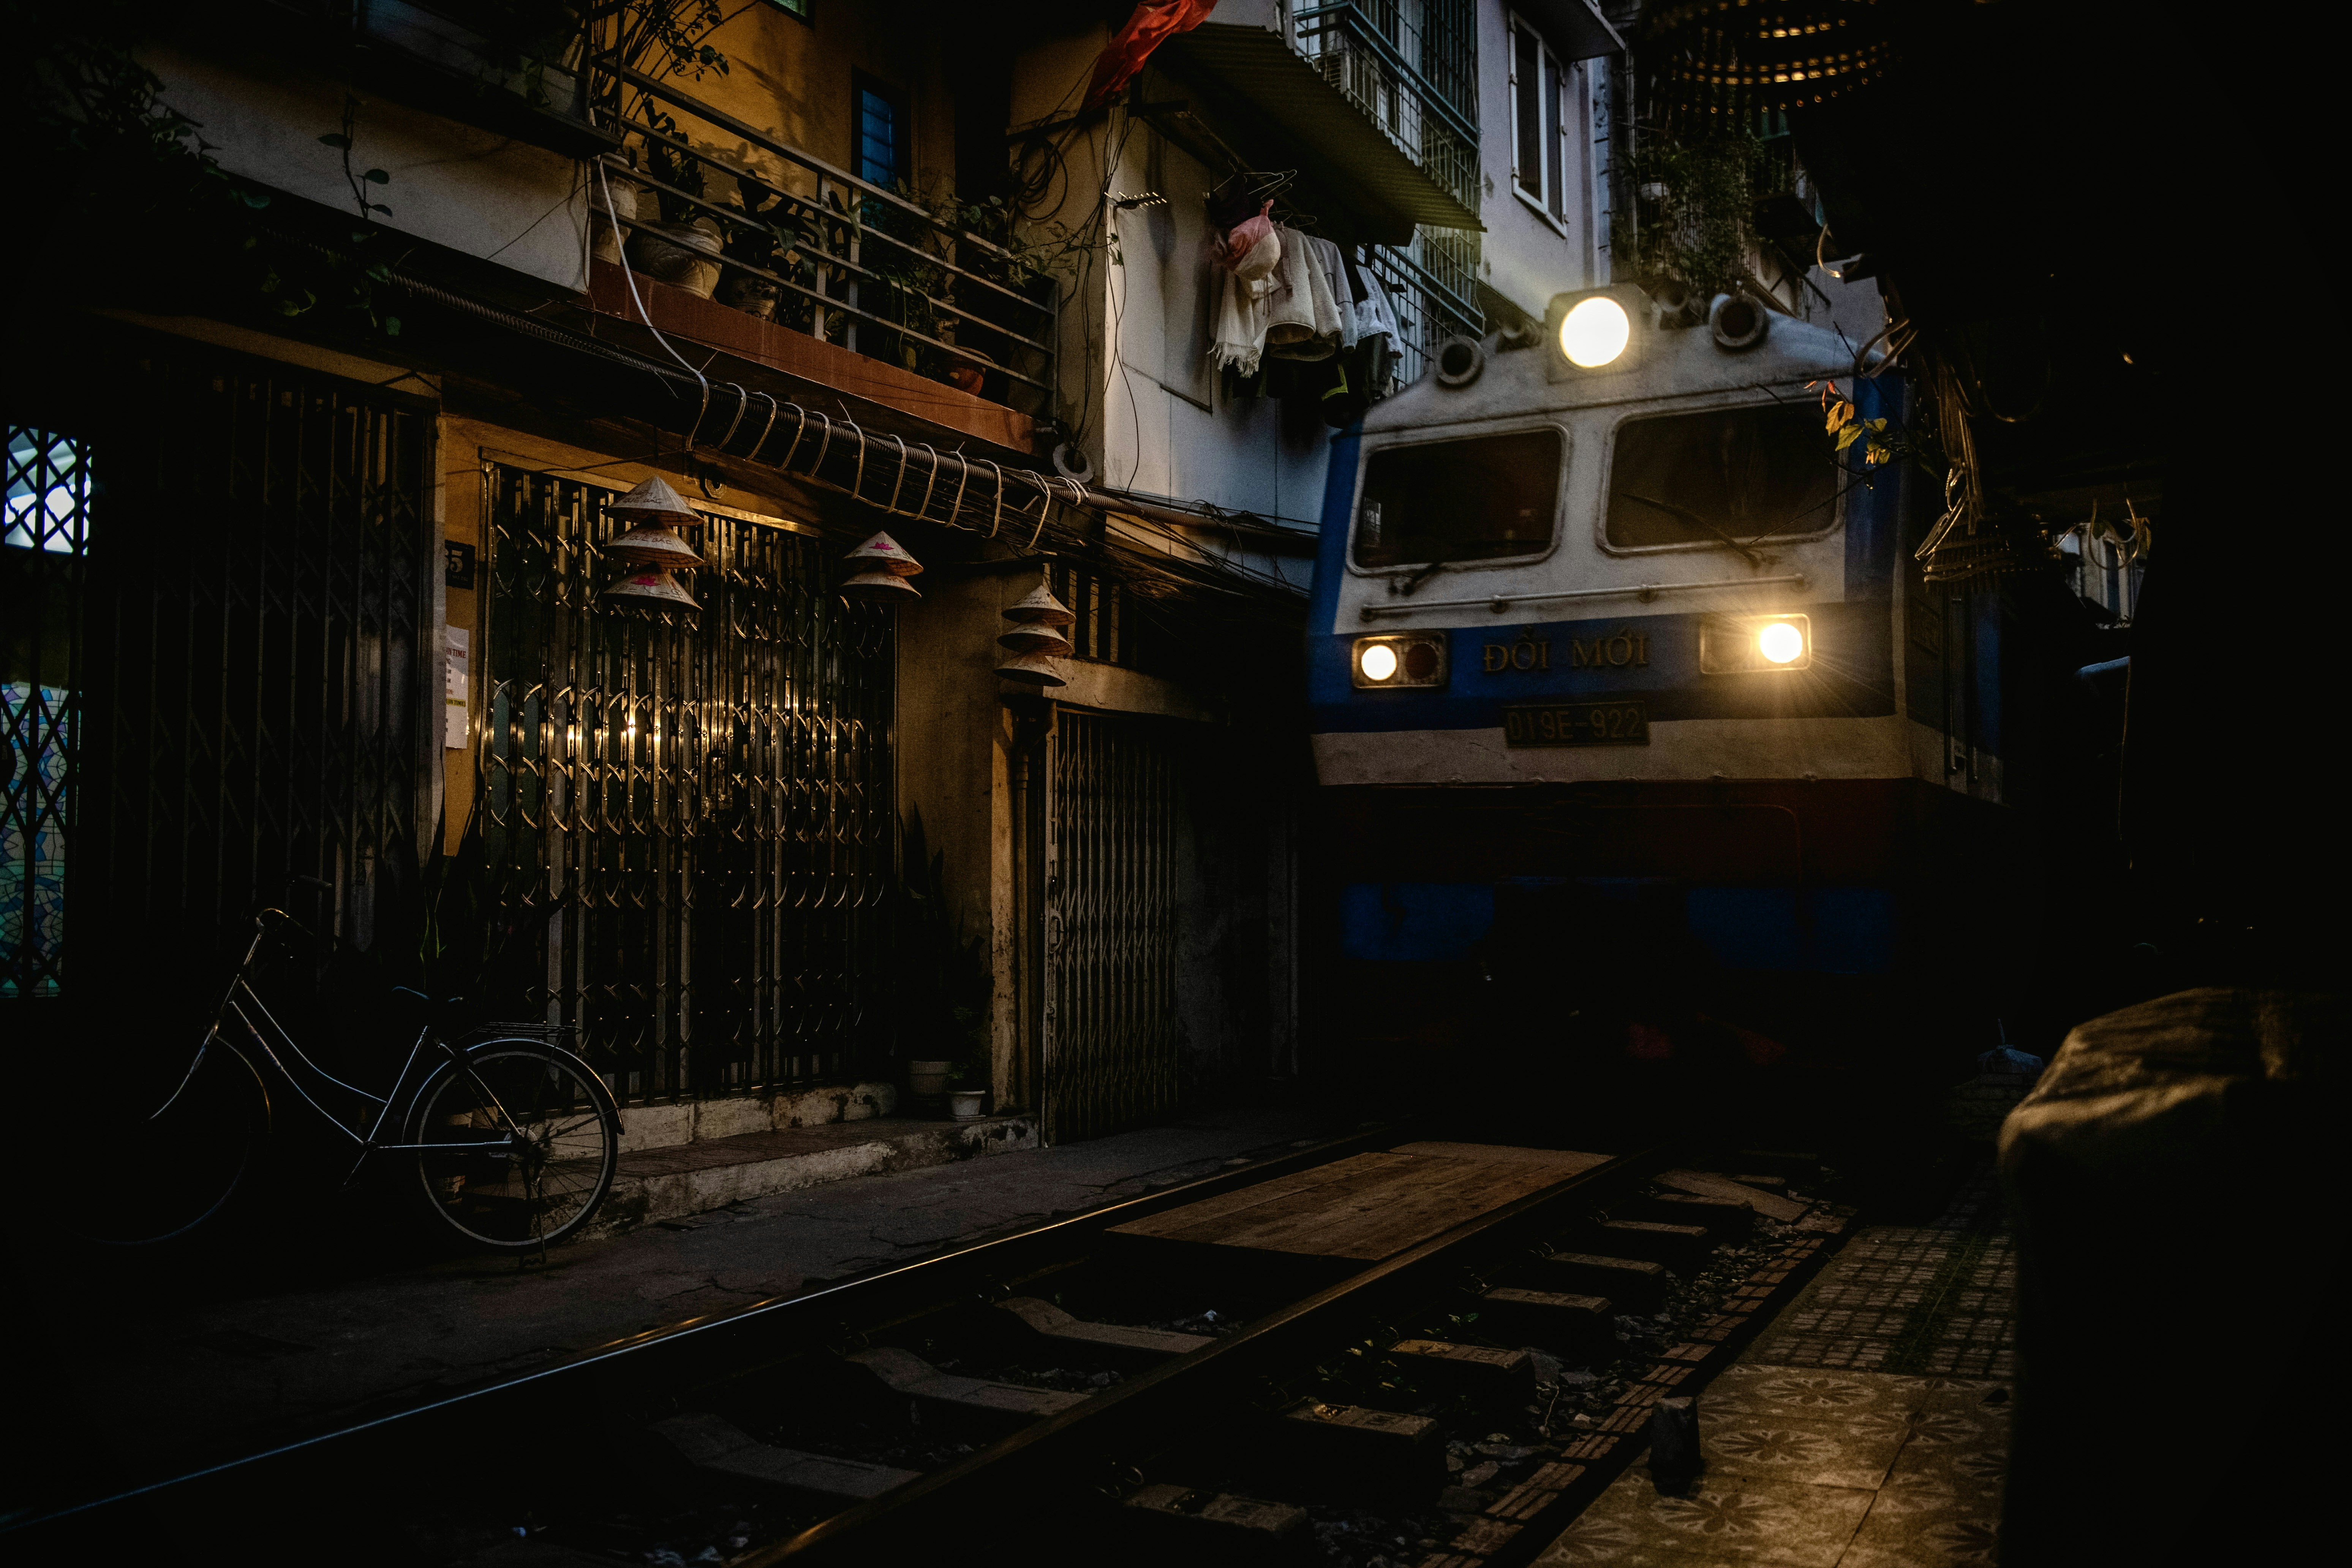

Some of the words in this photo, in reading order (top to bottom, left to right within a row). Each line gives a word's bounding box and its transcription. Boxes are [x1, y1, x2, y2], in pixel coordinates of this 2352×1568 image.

[651, 536, 673, 545] BÁC
[452, 648, 466, 658] TIME
[1483, 623, 1552, 673] ĐỔI
[1570, 628, 1650, 669] MỚI
[1507, 707, 1642, 741] D19E-922
